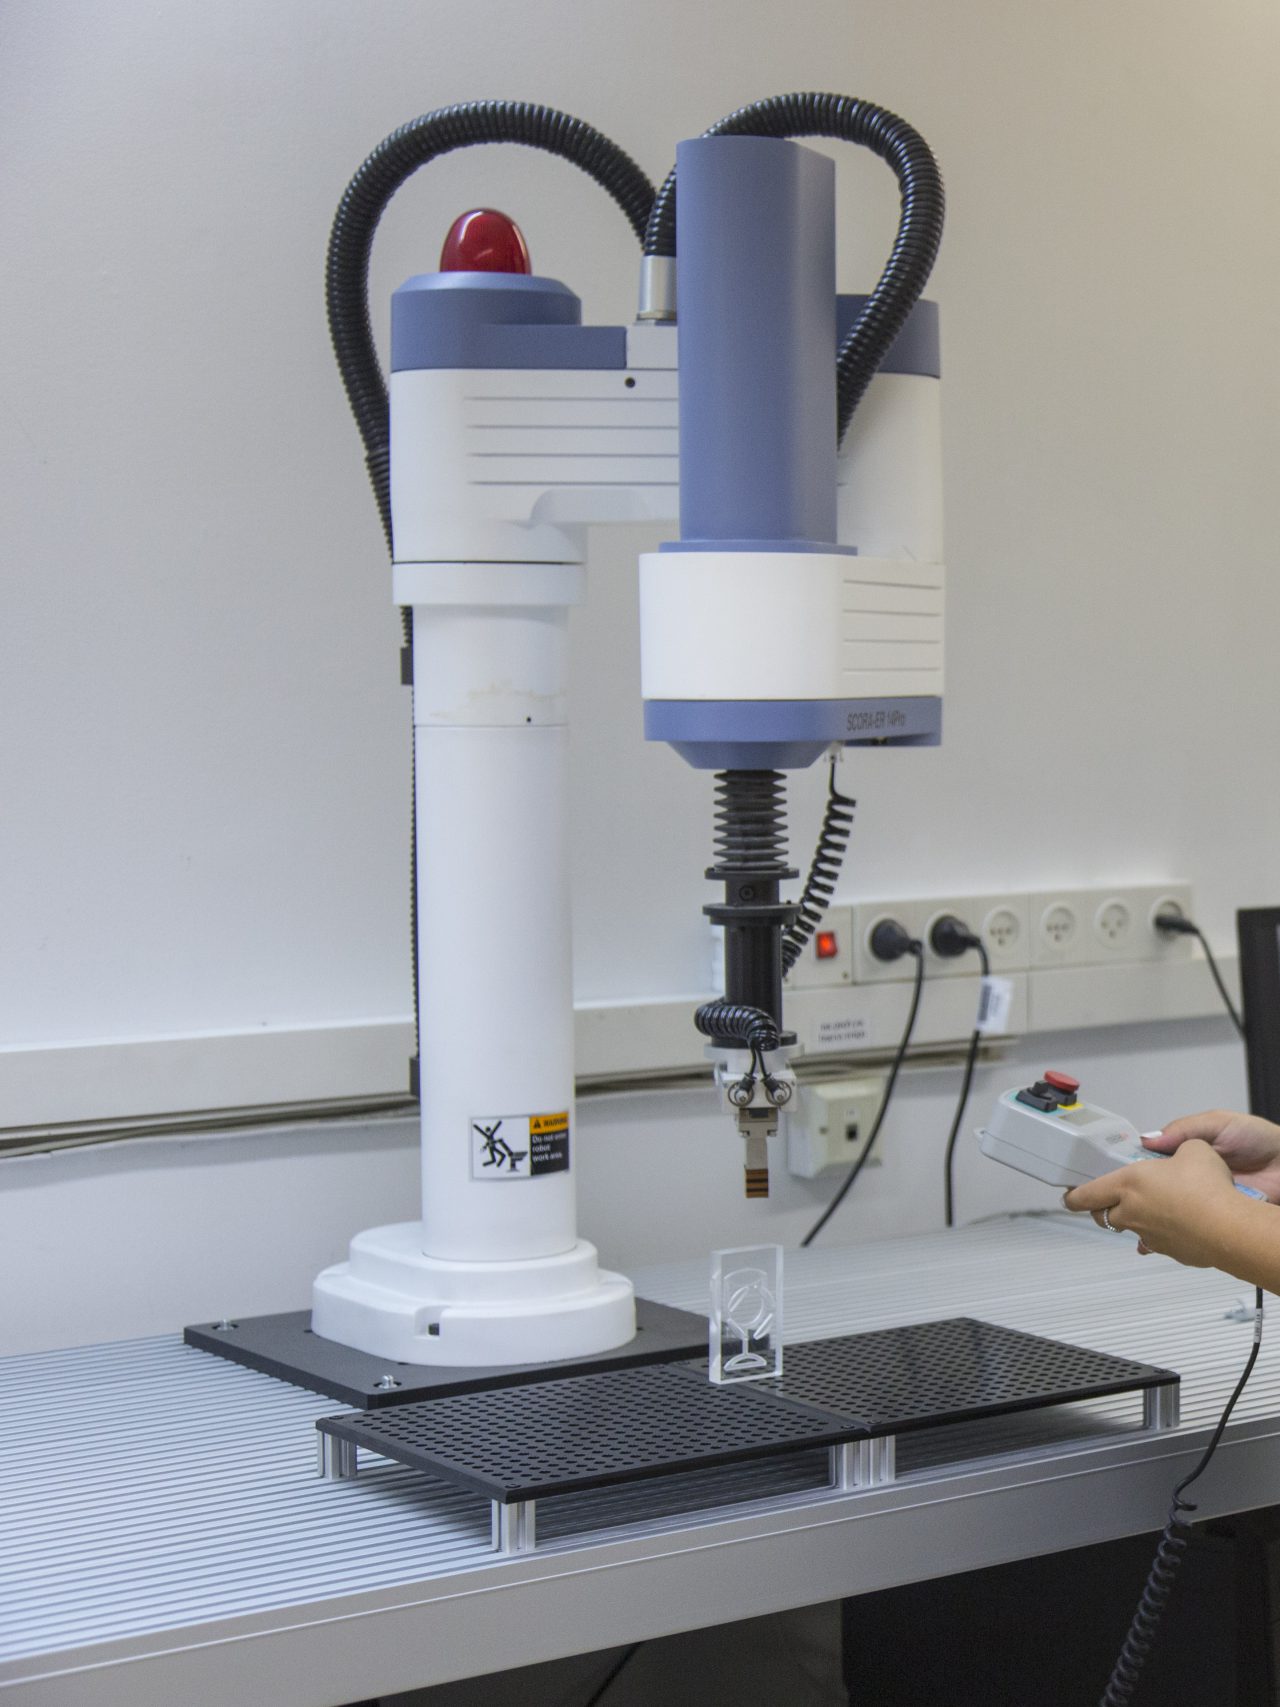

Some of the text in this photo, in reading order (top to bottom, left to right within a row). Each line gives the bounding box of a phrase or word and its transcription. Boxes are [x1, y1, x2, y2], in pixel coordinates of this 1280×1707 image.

[532, 1134, 542, 1143] Do
[532, 1143, 551, 1152] robot
[532, 1153, 549, 1162] work
